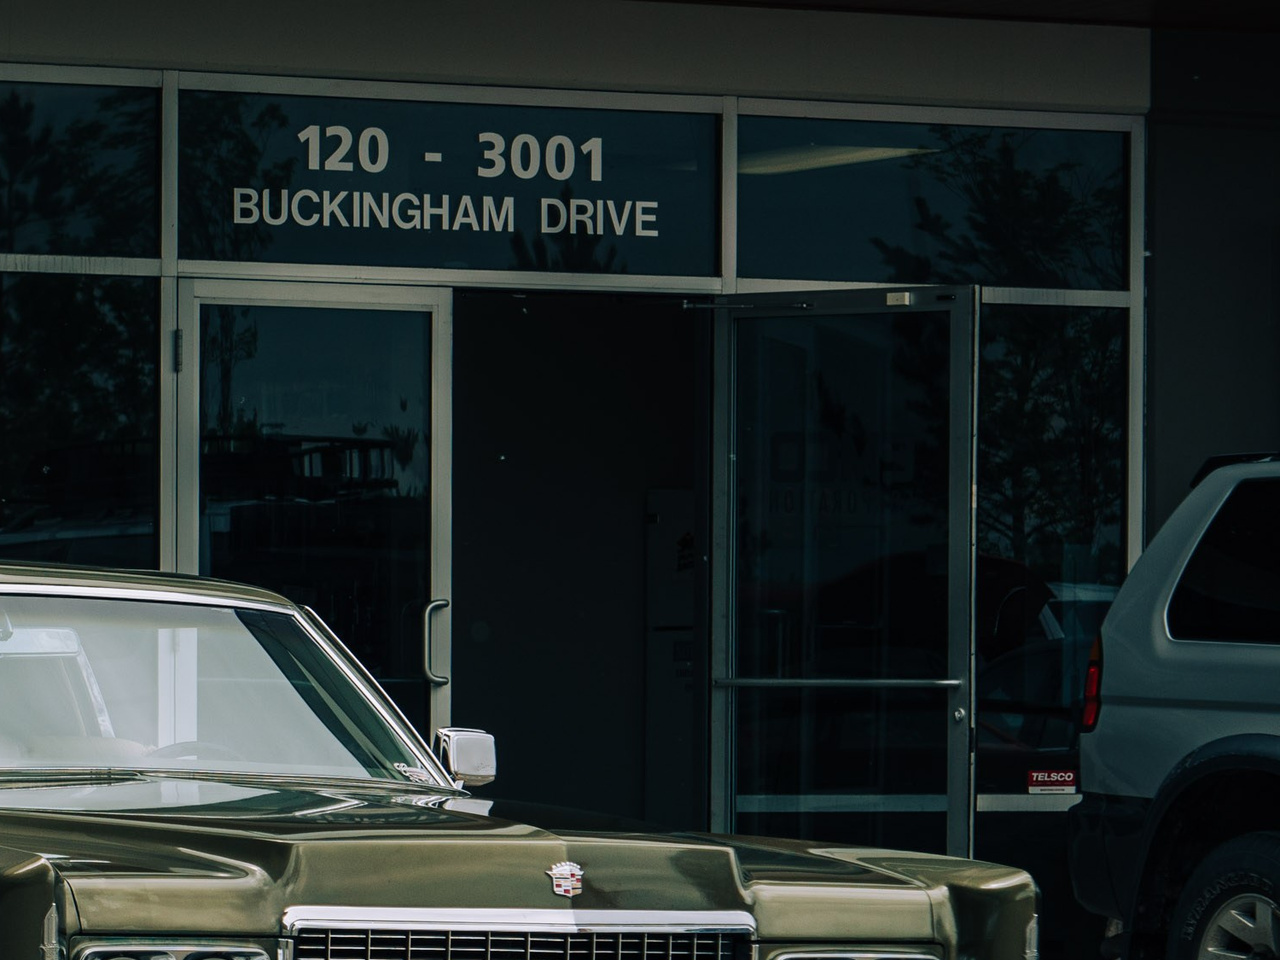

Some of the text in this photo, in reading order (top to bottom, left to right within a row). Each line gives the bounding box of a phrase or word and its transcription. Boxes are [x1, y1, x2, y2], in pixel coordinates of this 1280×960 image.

[297, 125, 389, 173] 120
[477, 132, 603, 182] 3001
[233, 187, 659, 237] BUCKINGHAM DRIVE
[1031, 772, 1074, 782] TELSCO
